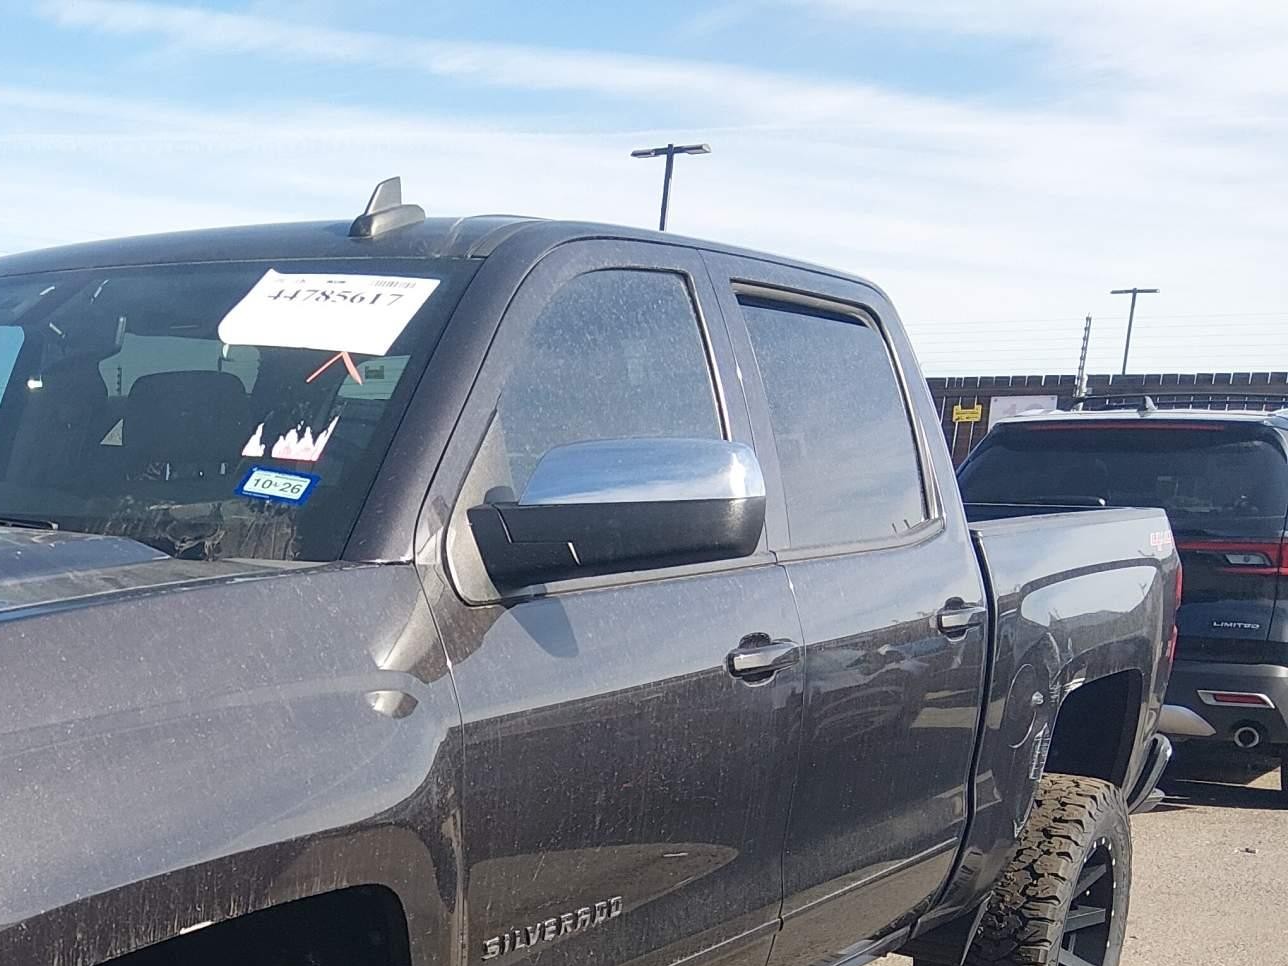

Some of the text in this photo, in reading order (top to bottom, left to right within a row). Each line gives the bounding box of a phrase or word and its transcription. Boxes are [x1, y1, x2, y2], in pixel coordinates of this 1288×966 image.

[268, 288, 404, 306] 44785617
[1213, 621, 1260, 630] LIMITED
[482, 896, 623, 961] SILVERADO
